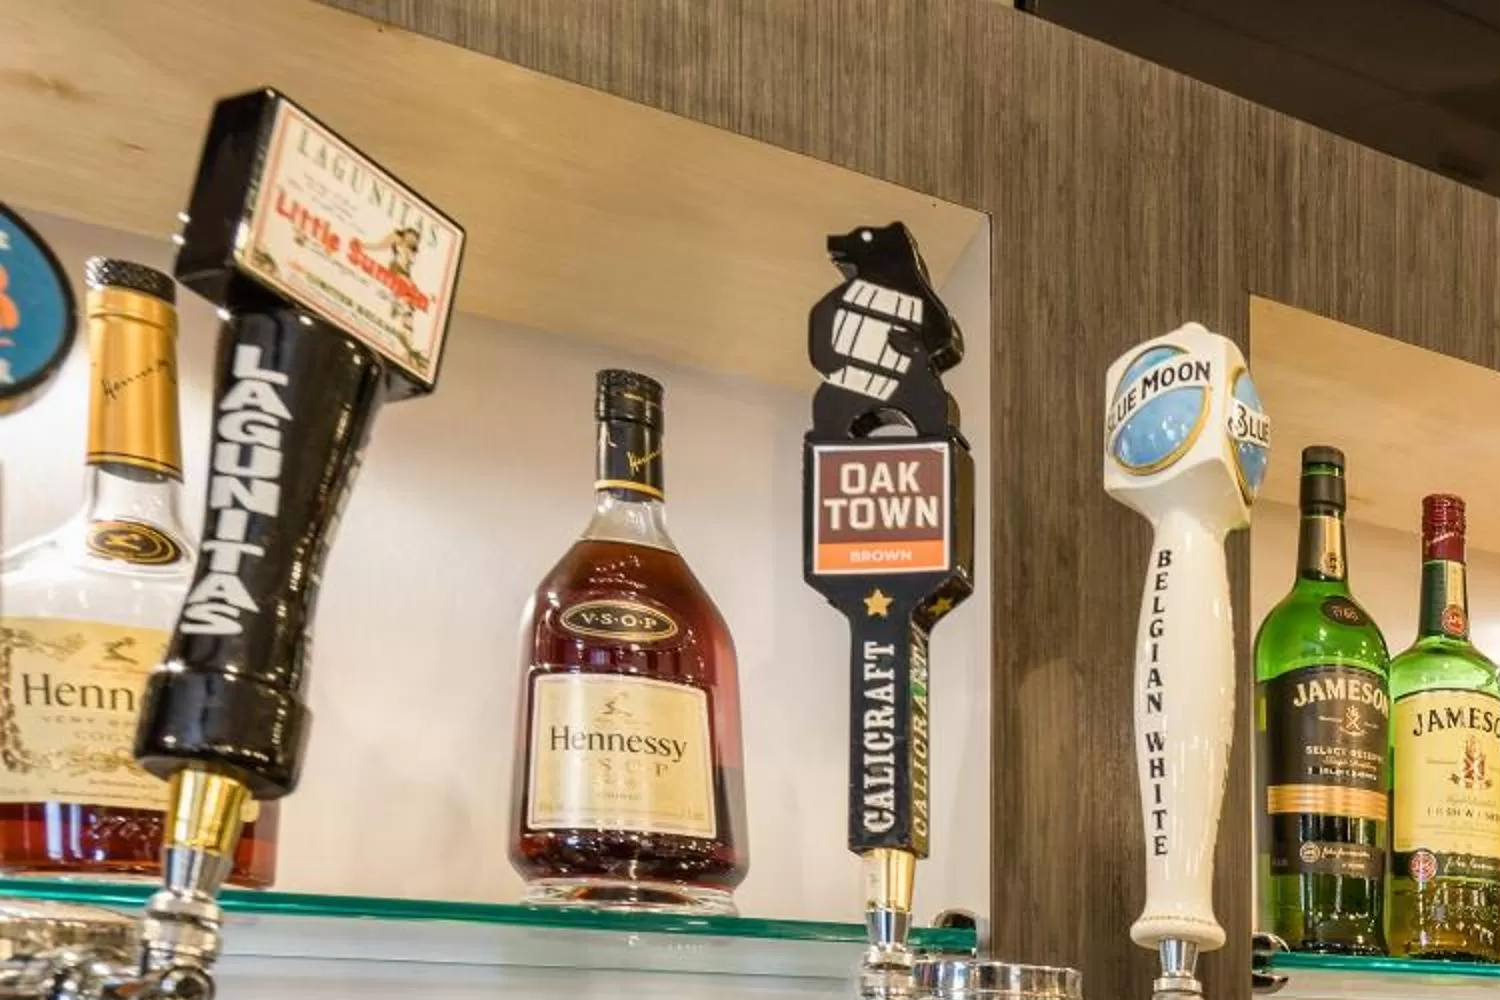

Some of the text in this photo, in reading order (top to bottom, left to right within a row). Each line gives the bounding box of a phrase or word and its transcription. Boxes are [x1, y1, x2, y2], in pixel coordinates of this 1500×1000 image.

[275, 184, 341, 256] Little
[1141, 361, 1212, 400] MOON
[180, 344, 293, 635] LAGUNITAS
[840, 461, 921, 494] OAK
[823, 496, 939, 531] TOWN
[848, 549, 913, 562] BROWN
[22, 673, 135, 711] Henn
[1145, 549, 1172, 857] BELGIAN WHITE
[1293, 678, 1389, 720] JAMESON
[551, 725, 688, 763] Hennessy
[863, 641, 895, 834] CALICRAFT
